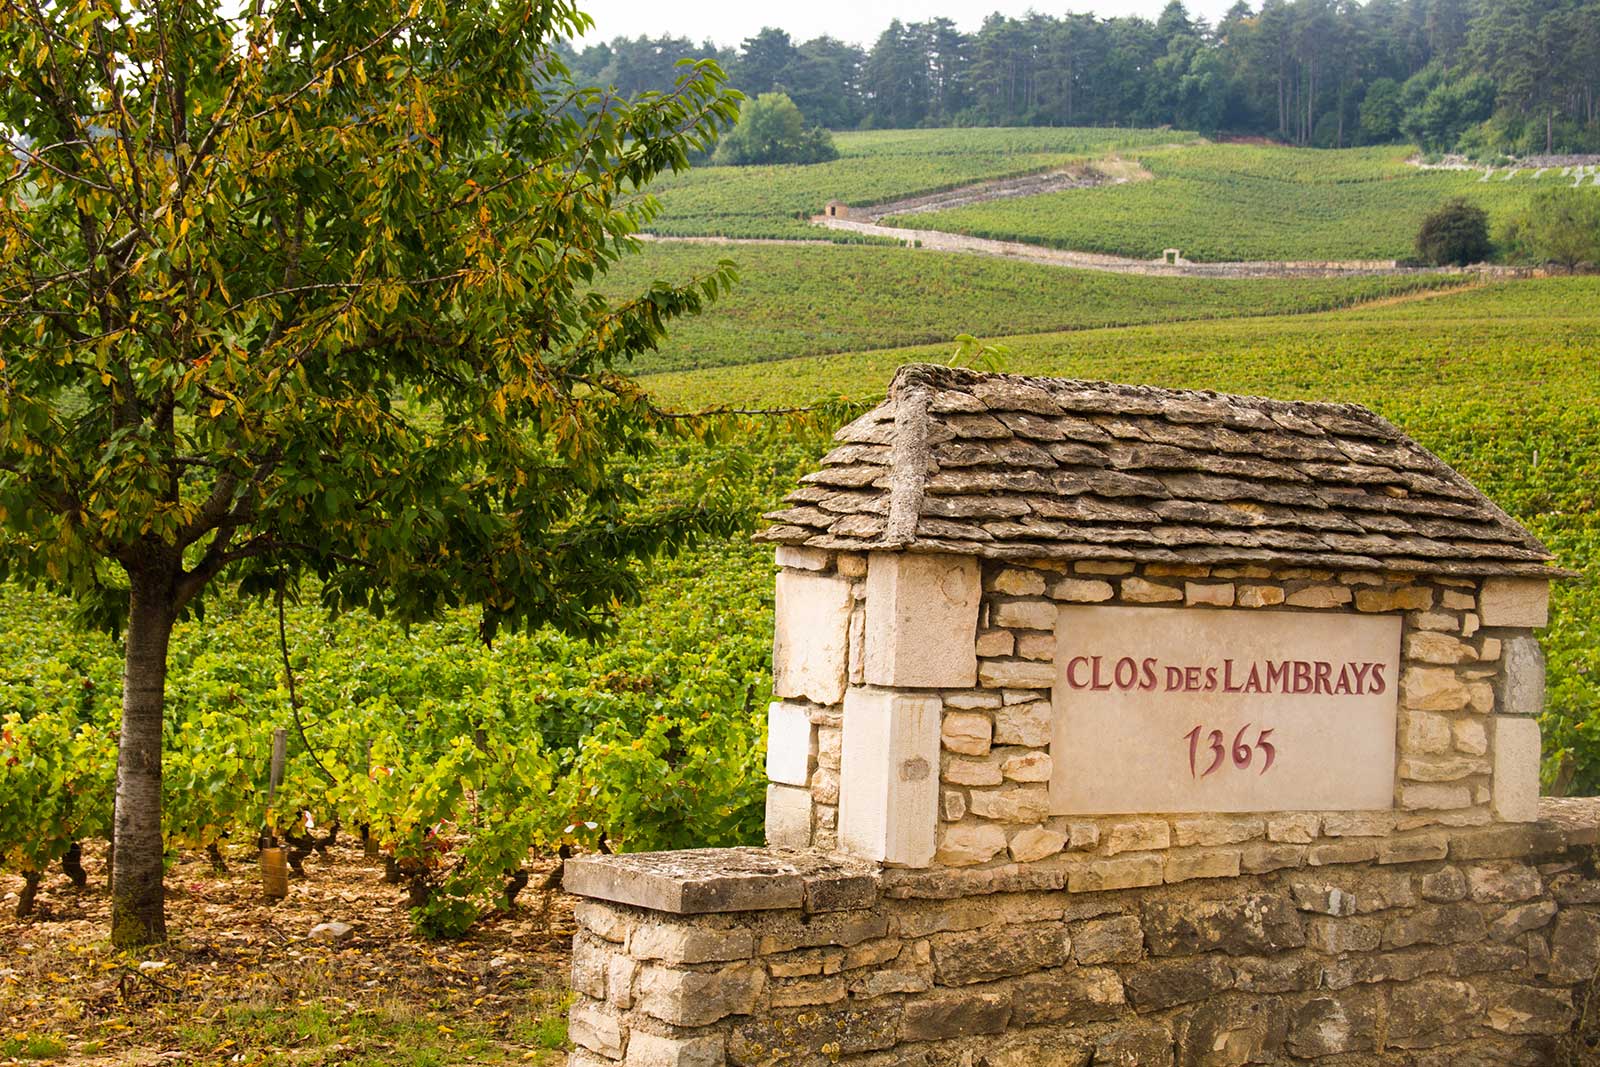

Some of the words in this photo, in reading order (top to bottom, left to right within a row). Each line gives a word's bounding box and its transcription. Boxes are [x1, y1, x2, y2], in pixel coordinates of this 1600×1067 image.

[1066, 655, 1158, 692] CLOS
[1164, 666, 1218, 693] DES
[1222, 659, 1387, 696] LAMBRAYS
[1183, 723, 1276, 780] 1365
